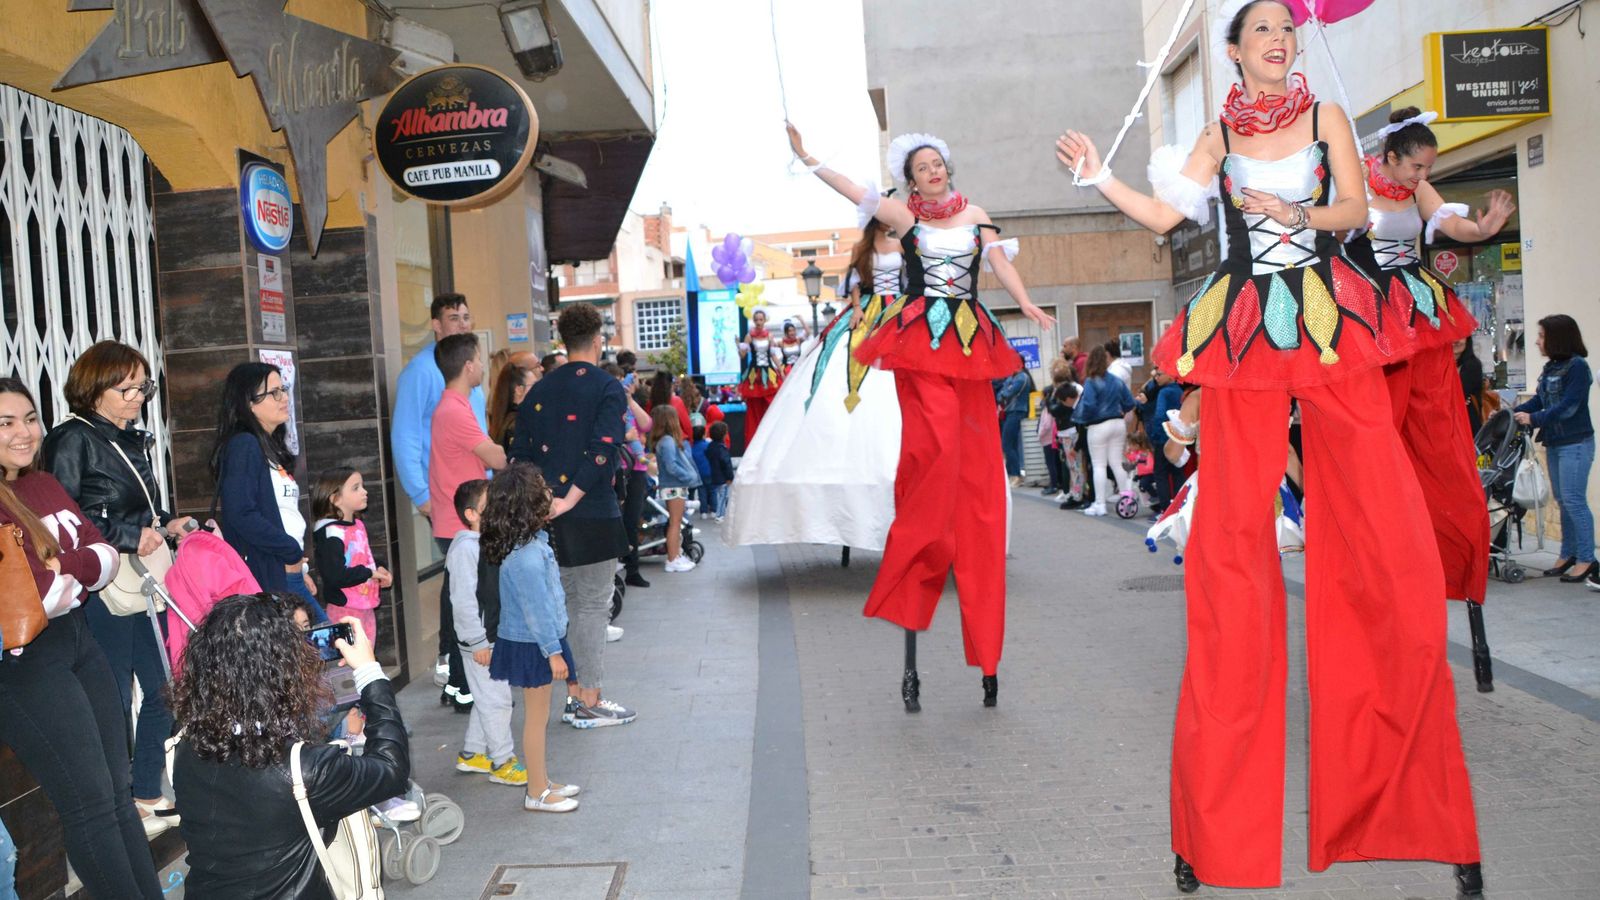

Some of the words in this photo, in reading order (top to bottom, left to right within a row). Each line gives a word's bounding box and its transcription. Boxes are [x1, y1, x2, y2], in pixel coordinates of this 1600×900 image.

[114, 0, 186, 60] Pub
[1456, 81, 1507, 91] WESTERN
[1472, 89, 1507, 97] UNION
[1517, 77, 1539, 94] yes!
[1508, 98, 1518, 106] de
[390, 101, 508, 143] Alhambra
[405, 140, 492, 159] CERVEZAS
[407, 169, 429, 183] CAFE
[432, 167, 452, 180] PUB
[454, 164, 492, 178] MANILA
